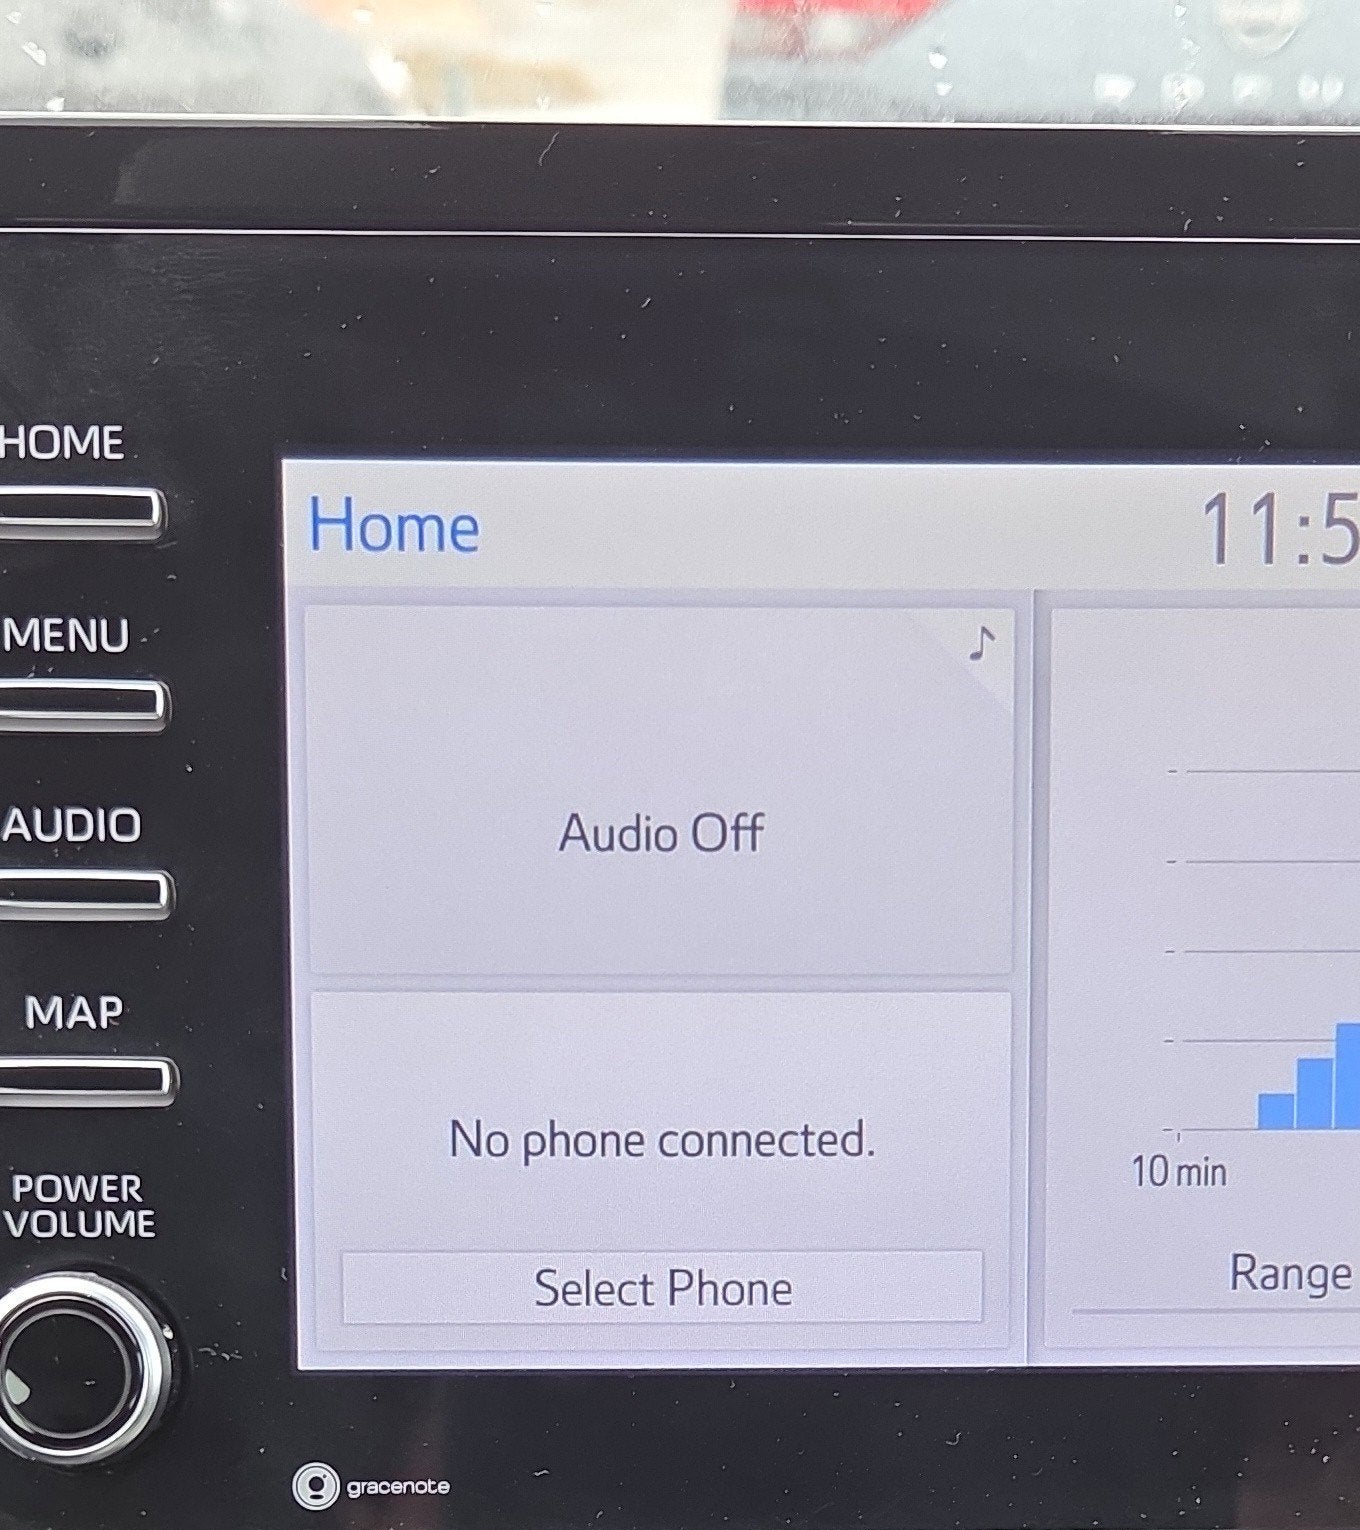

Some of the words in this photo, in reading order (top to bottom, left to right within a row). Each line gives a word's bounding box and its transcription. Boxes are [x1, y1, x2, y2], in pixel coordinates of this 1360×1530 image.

[309, 496, 480, 553] Home
[3, 617, 129, 653] MENU
[1, 806, 141, 843] AUDIO
[559, 812, 678, 853] Audio
[691, 812, 766, 853] Off
[26, 995, 123, 1029] MAP
[449, 1119, 510, 1158] No
[522, 1119, 645, 1166] phone
[658, 1119, 876, 1158] connected.
[1132, 1154, 1168, 1186] 10
[1176, 1157, 1228, 1186] min
[12, 1174, 143, 1203] POWER
[2, 1210, 156, 1238] VOLUME
[535, 1269, 655, 1308] Select
[668, 1269, 792, 1307] Phone
[1230, 1253, 1353, 1298] Range
[346, 1476, 451, 1499] gracenote
